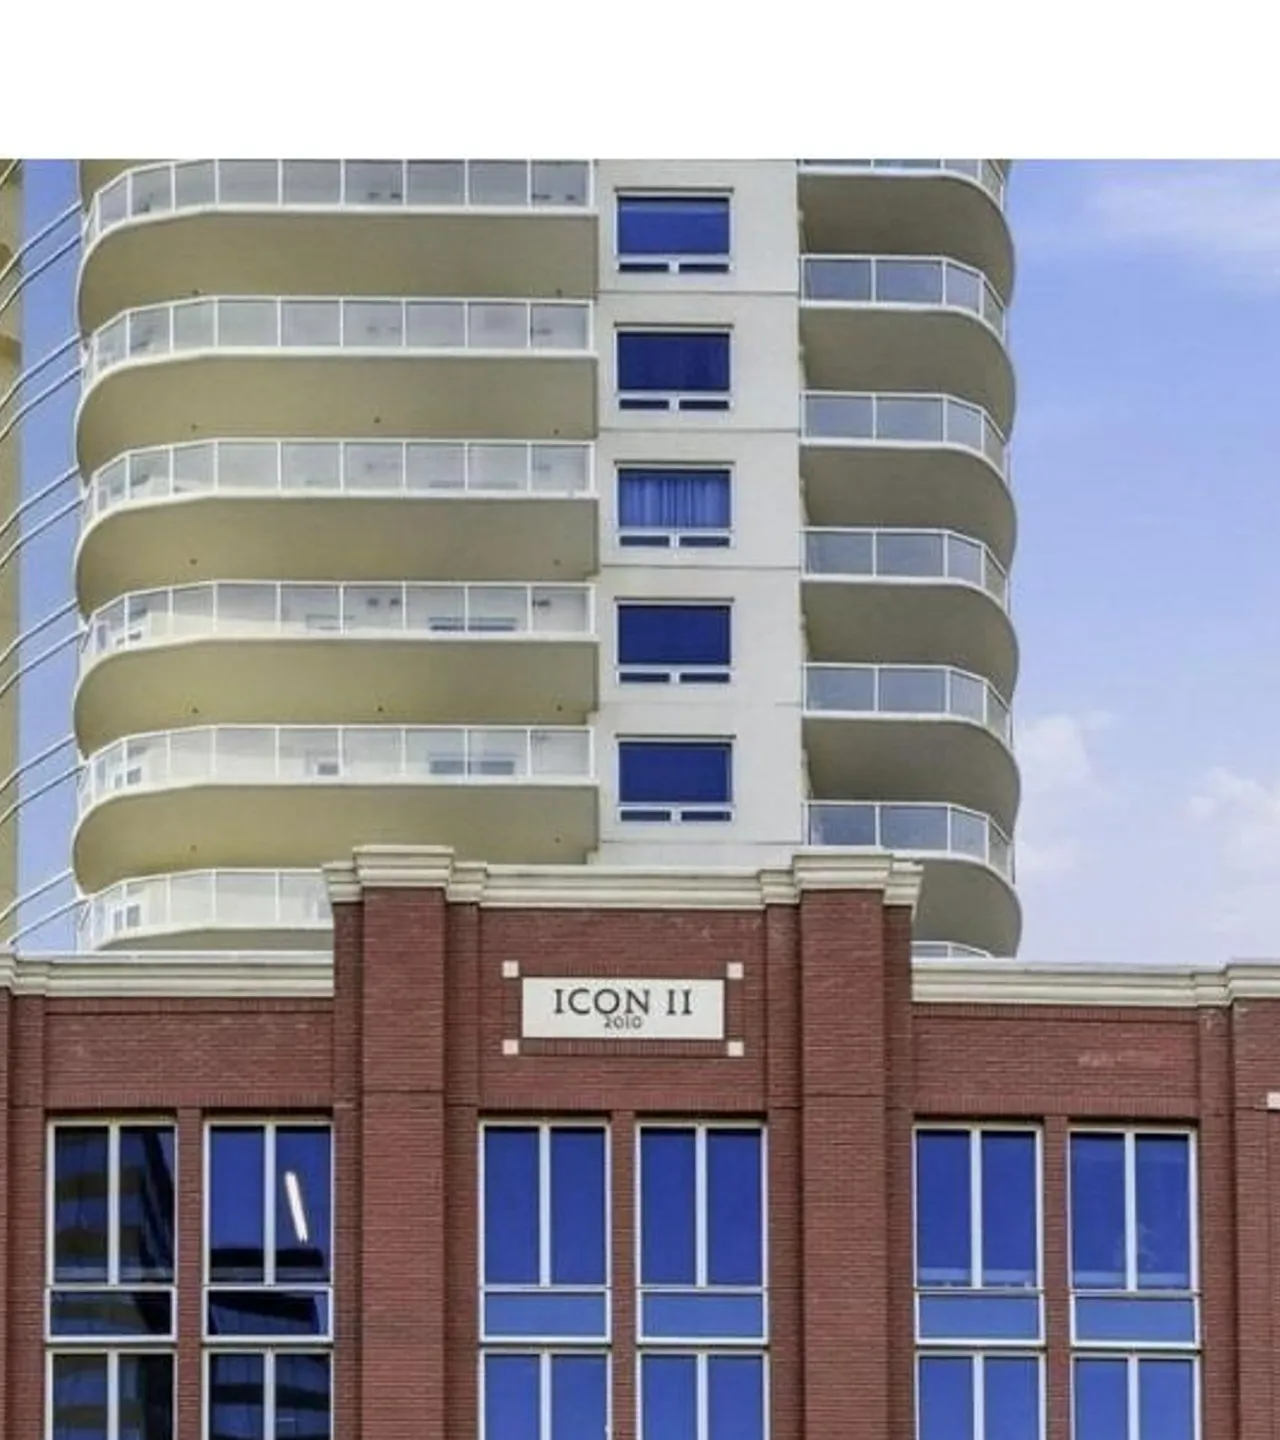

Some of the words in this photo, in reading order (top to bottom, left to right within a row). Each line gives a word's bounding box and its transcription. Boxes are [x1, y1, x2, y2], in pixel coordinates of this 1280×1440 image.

[554, 988, 650, 1014] ICON
[667, 989, 693, 1014] II
[604, 1014, 643, 1029] 2010
